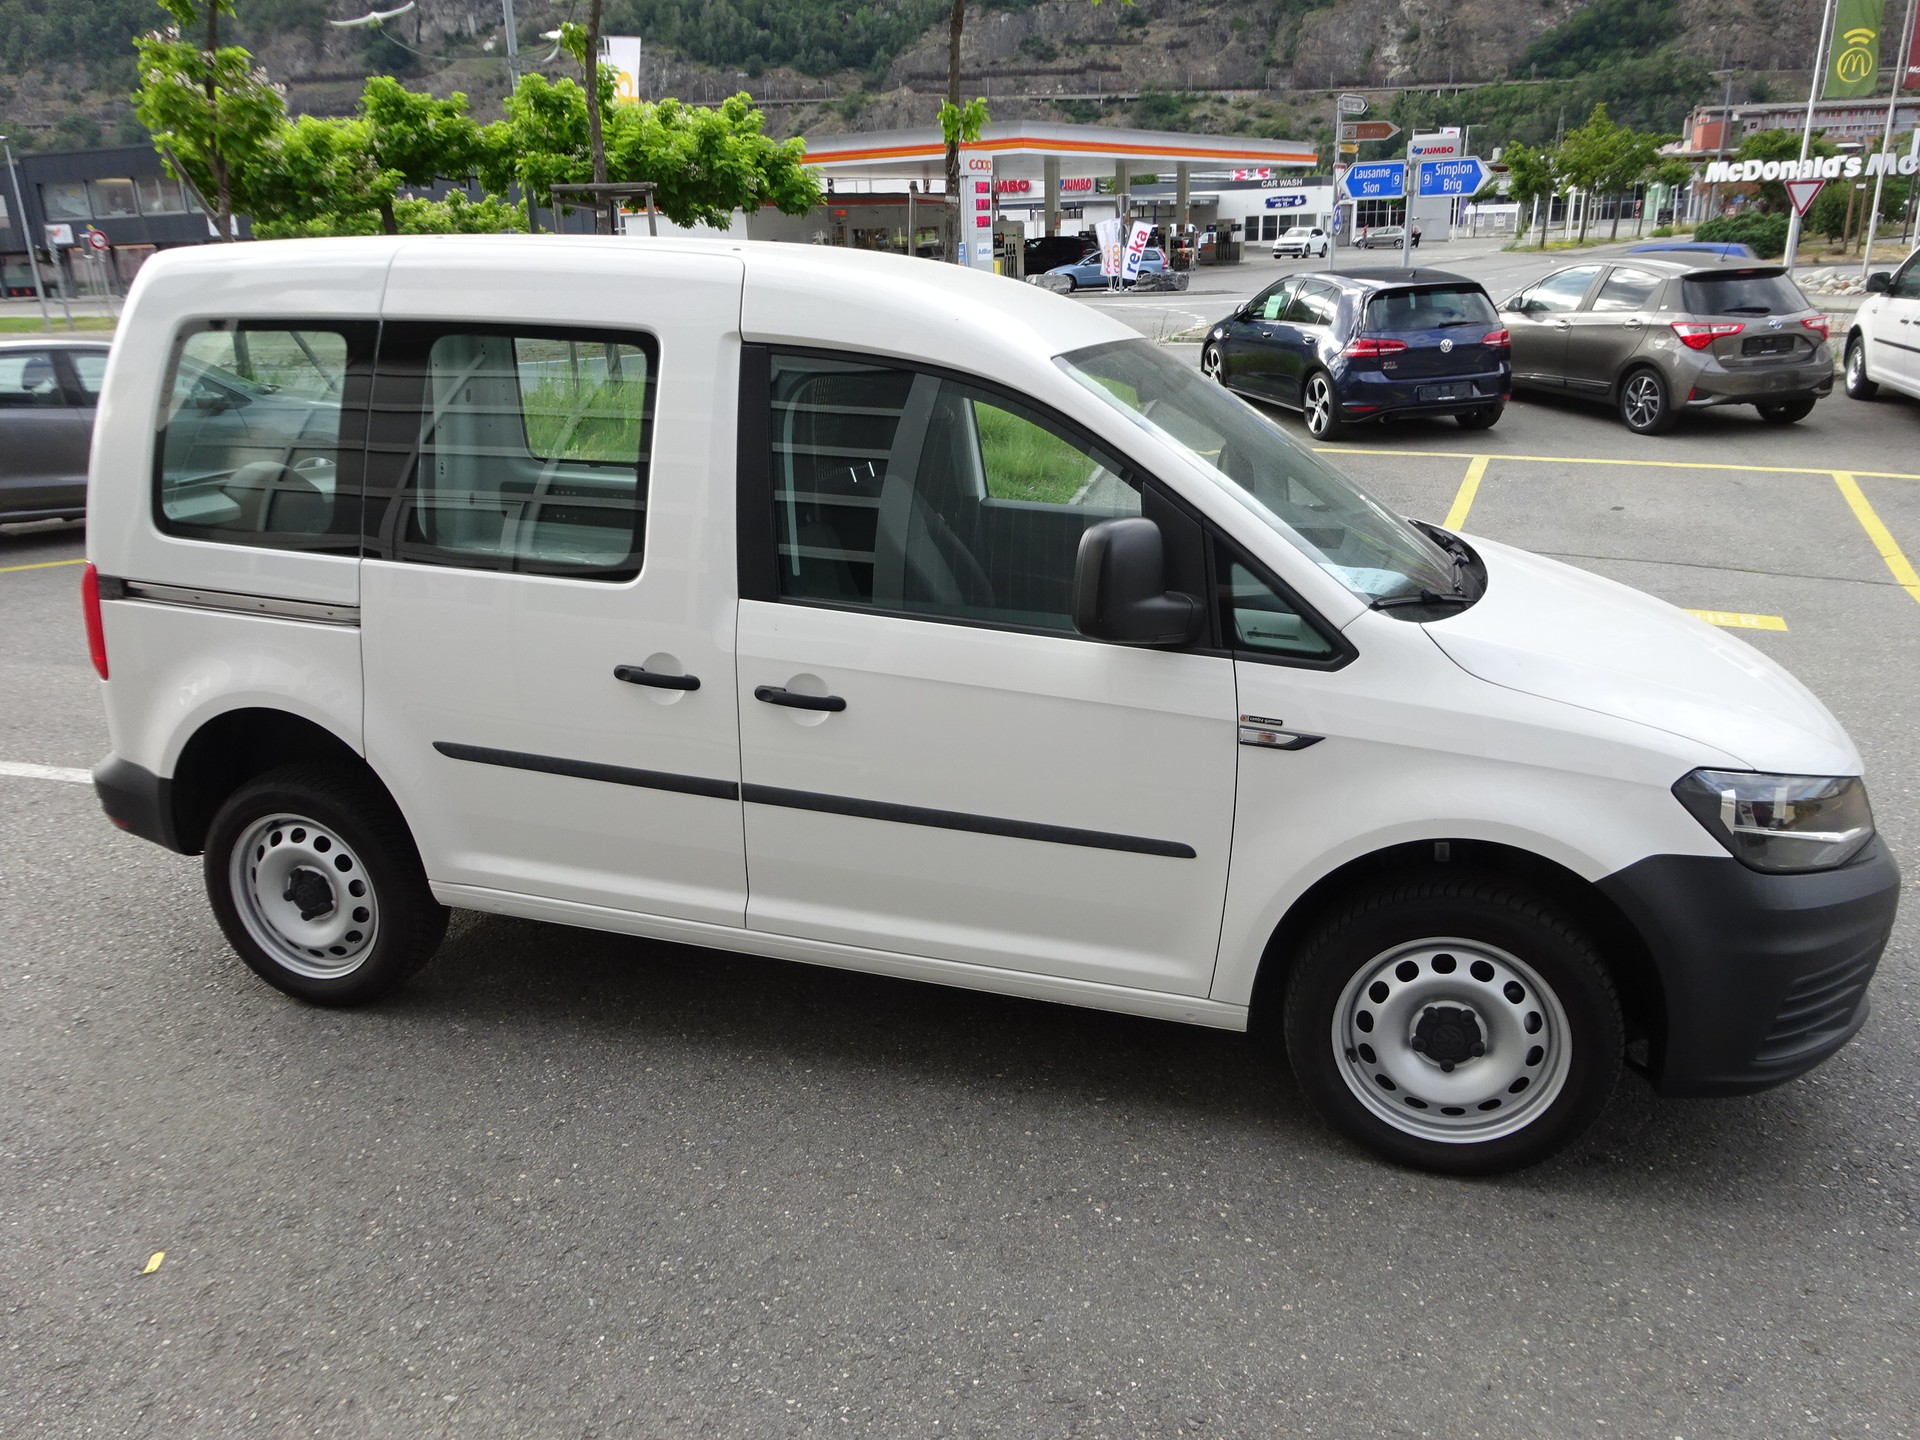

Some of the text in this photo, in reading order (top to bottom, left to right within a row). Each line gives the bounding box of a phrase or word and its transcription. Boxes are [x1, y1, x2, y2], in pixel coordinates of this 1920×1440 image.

[1422, 146, 1454, 155] JUMBO
[969, 159, 992, 174] coop
[1435, 162, 1473, 178] Simplon
[1704, 155, 1863, 183] McDonald's
[1353, 167, 1391, 180] Lausanne
[1393, 173, 1401, 185] 9
[1423, 173, 1431, 185] 9
[1062, 177, 1092, 191] JUMBO
[1261, 178, 1303, 188] CAR WASH
[1362, 181, 1380, 194] Sion
[1443, 178, 1463, 193] Brig
[1126, 229, 1149, 274] reka
